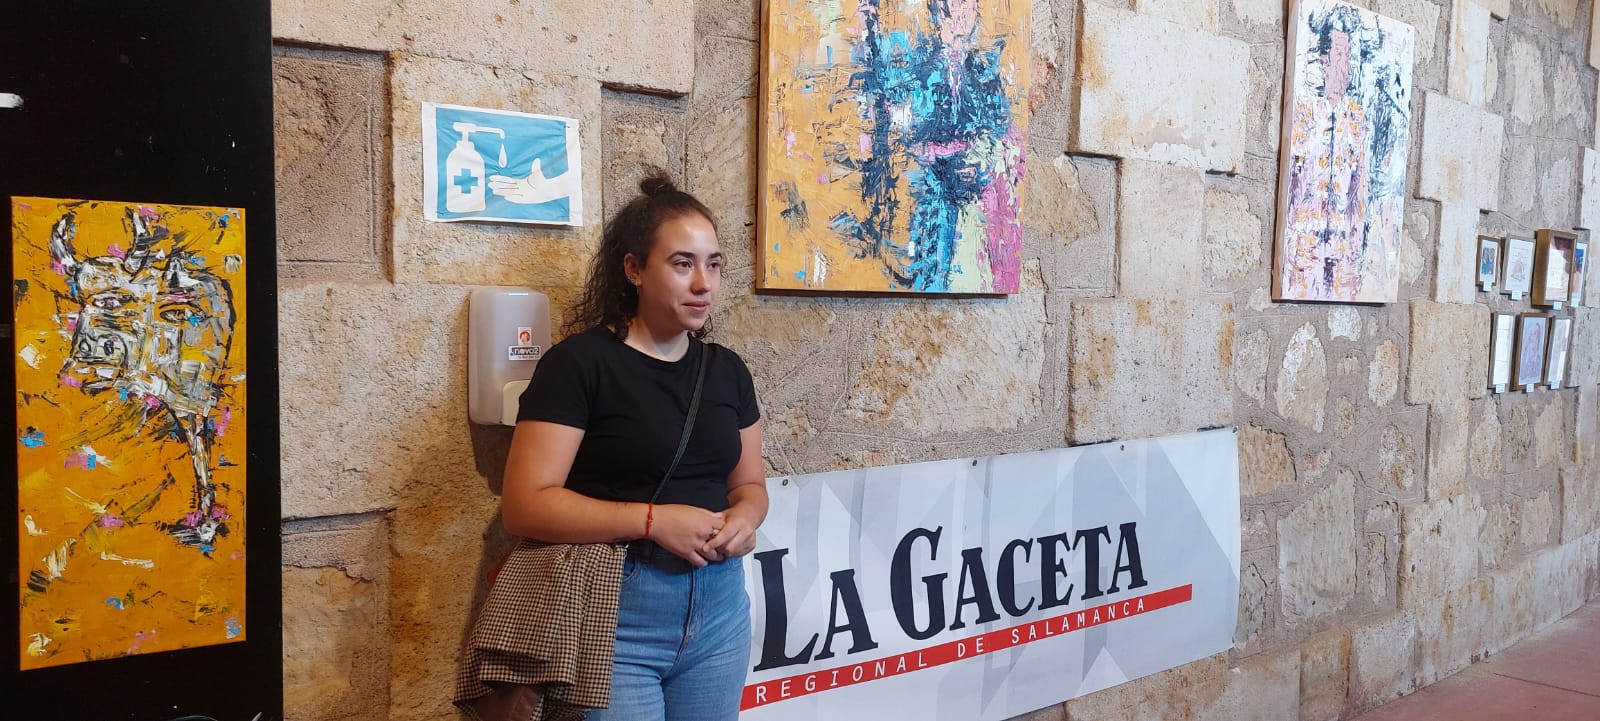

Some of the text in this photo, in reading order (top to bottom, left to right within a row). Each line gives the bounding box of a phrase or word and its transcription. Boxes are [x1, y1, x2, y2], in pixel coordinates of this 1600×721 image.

[753, 522, 1148, 672] LA GACETA
[756, 598, 1145, 704] REGIONAL DE SALAMANCA
